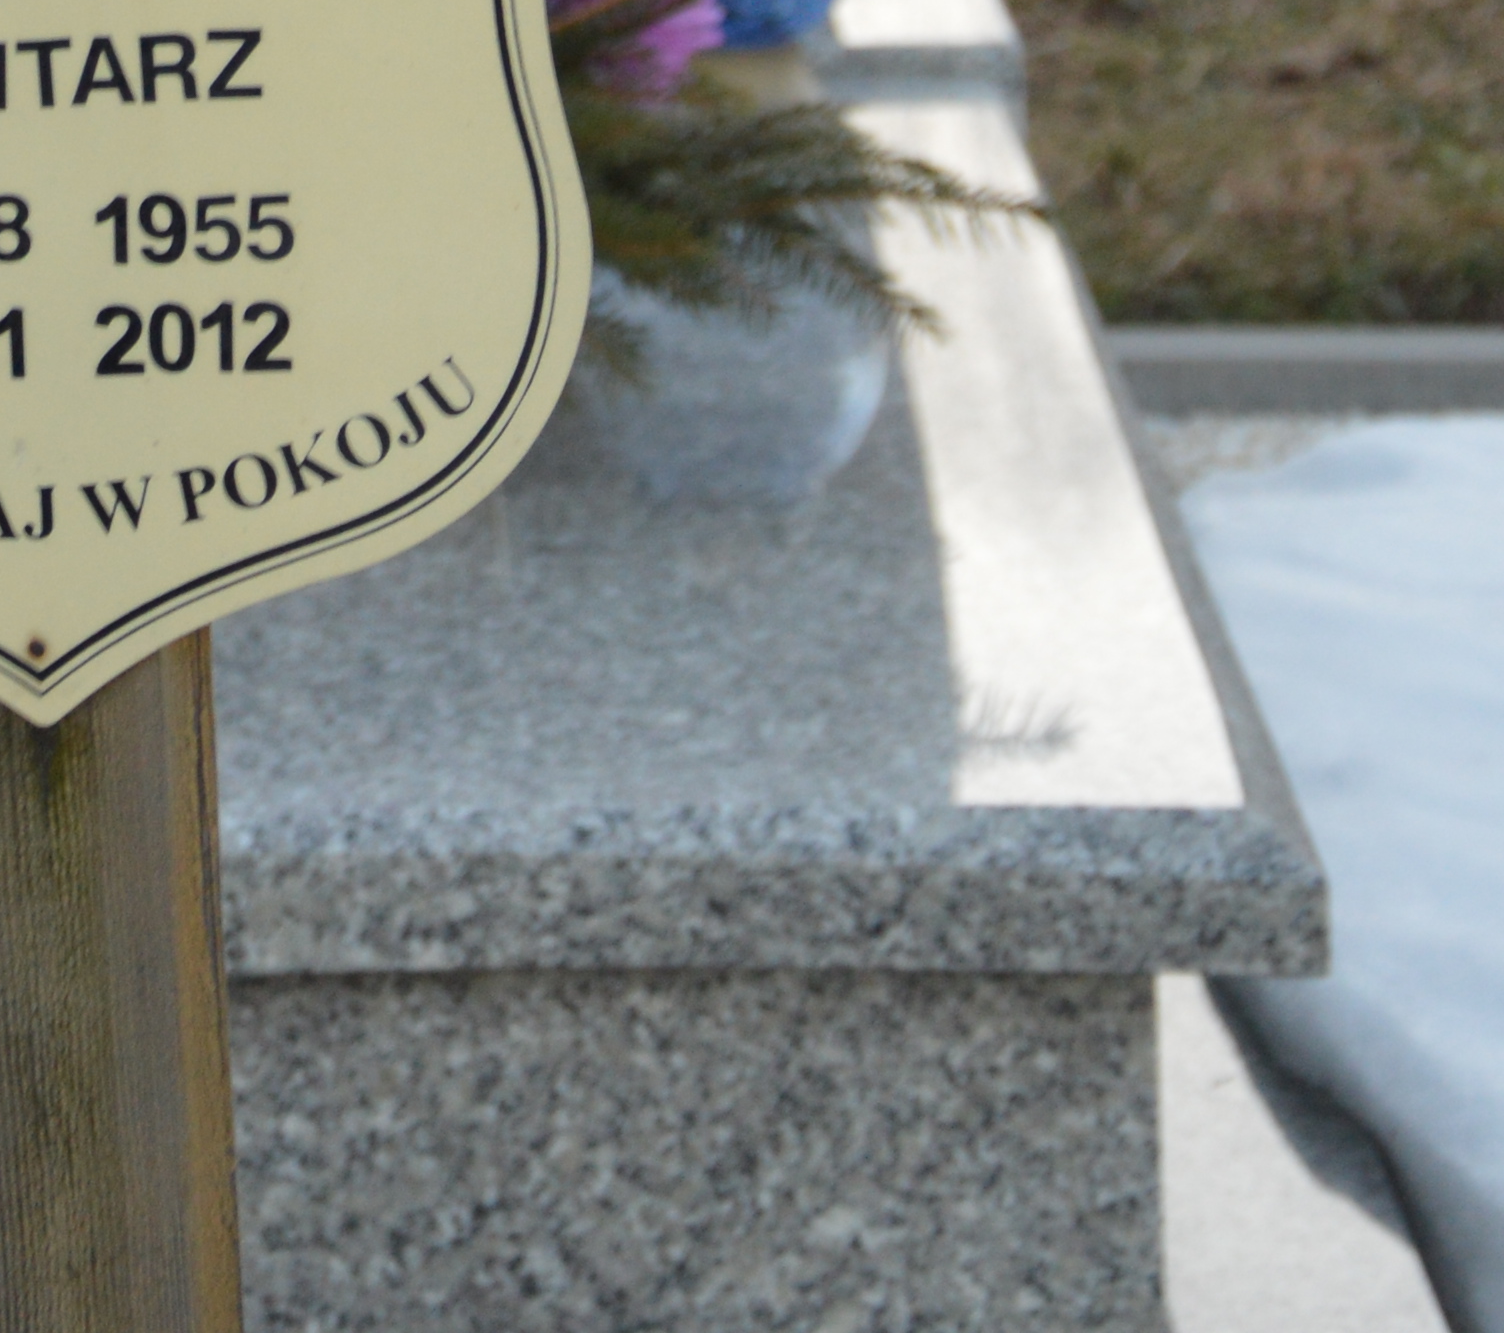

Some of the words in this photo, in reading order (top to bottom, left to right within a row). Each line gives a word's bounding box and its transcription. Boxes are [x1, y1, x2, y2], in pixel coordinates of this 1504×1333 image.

[95, 194, 296, 265] 1955
[95, 301, 294, 376] 2012
[80, 476, 152, 534] W
[177, 355, 480, 524] POKOJU
